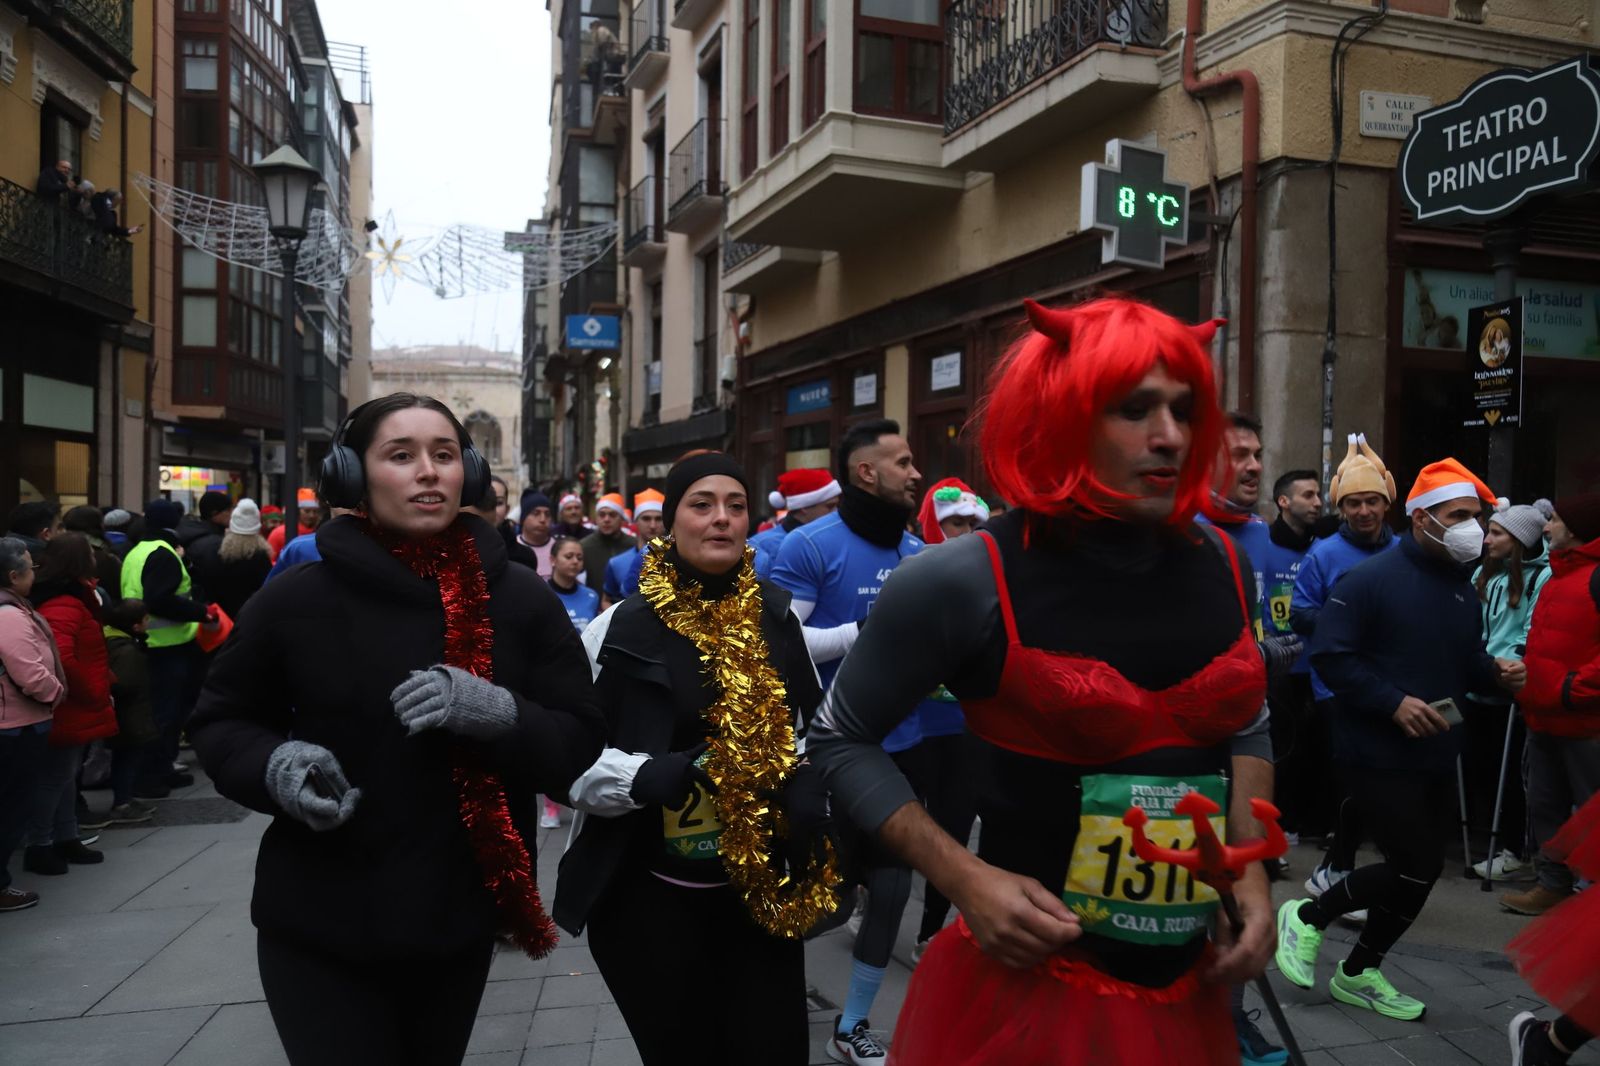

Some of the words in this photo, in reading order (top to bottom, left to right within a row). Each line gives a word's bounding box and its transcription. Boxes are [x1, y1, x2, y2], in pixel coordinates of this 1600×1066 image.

[1386, 100, 1415, 110] CALLE
[1391, 112, 1403, 121] DE
[1442, 97, 1548, 152] TEATRO
[1427, 136, 1567, 197] PRINCIPAL
[1119, 187, 1136, 218] 8
[1450, 285, 1466, 298] Un
[1544, 291, 1583, 308] salud
[1527, 312, 1540, 323] su
[1543, 311, 1583, 327] familia
[1112, 912, 1160, 933] CAJA
